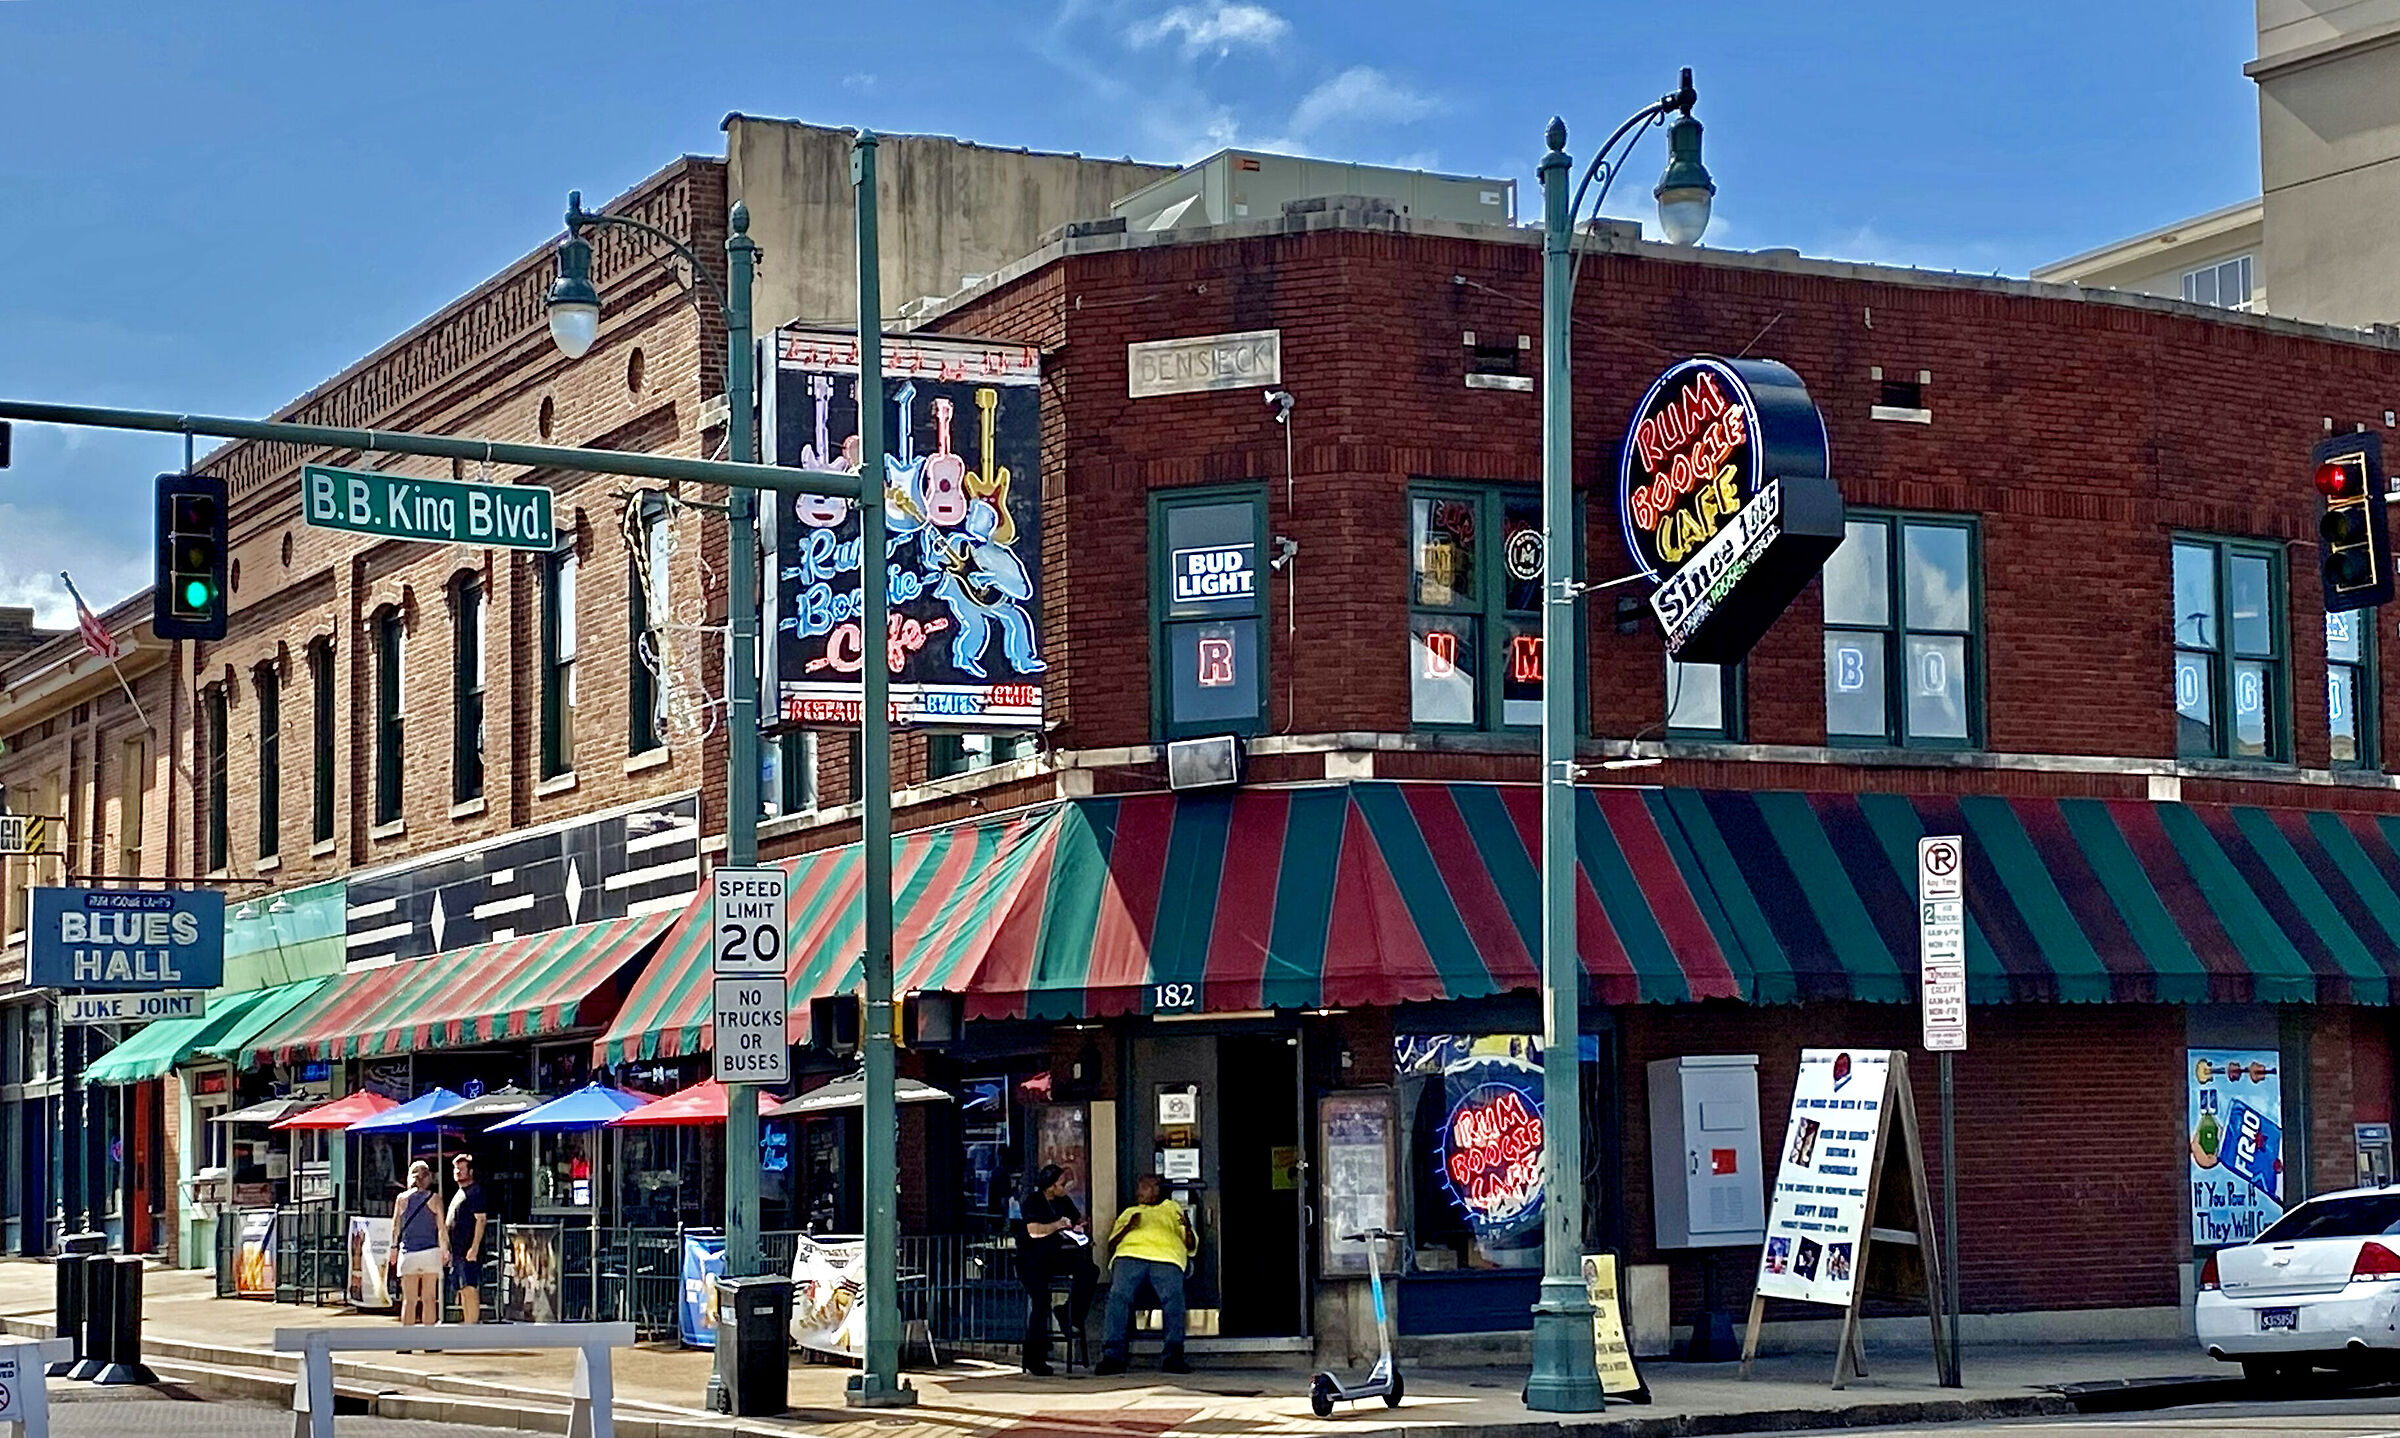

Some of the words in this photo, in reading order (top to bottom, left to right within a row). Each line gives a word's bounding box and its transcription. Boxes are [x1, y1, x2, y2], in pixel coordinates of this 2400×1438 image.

[1140, 342, 1272, 383] BENSIECK
[1636, 371, 1726, 473] RUM
[1631, 404, 1746, 531] BOOGIE
[312, 474, 381, 526] B.B.
[388, 483, 456, 539] King
[469, 491, 548, 541] Blvd.
[1656, 464, 1741, 562] CAFE
[1188, 550, 1243, 575] BUD
[1178, 571, 1254, 596] LIGHT
[827, 613, 927, 673] Cfe
[1427, 633, 1457, 677] U
[1513, 636, 1544, 680] M
[1198, 639, 1234, 684] R
[1838, 648, 1864, 691] B
[925, 693, 980, 715] BLUES
[719, 881, 782, 897] SPEED
[726, 903, 775, 919] LIMIT
[1924, 906, 1934, 923] 2
[61, 911, 199, 946] BLUES
[720, 924, 780, 962] 20
[74, 950, 182, 981] HALL
[71, 1000, 123, 1019] JUKE
[136, 996, 194, 1015] JOINT
[739, 990, 762, 1006] NO
[1154, 983, 1195, 1008] 182
[719, 1011, 783, 1028] TRUCKS
[740, 1034, 762, 1050] OR
[724, 1054, 779, 1071] BUSES
[1453, 1092, 1528, 1148] RUM
[1451, 1118, 1542, 1185] BOOGIE
[2234, 1109, 2260, 1178] FRIO
[2204, 1181, 2226, 1208] You
[2197, 1211, 2232, 1243] They
[2231, 1210, 2256, 1239] Will
